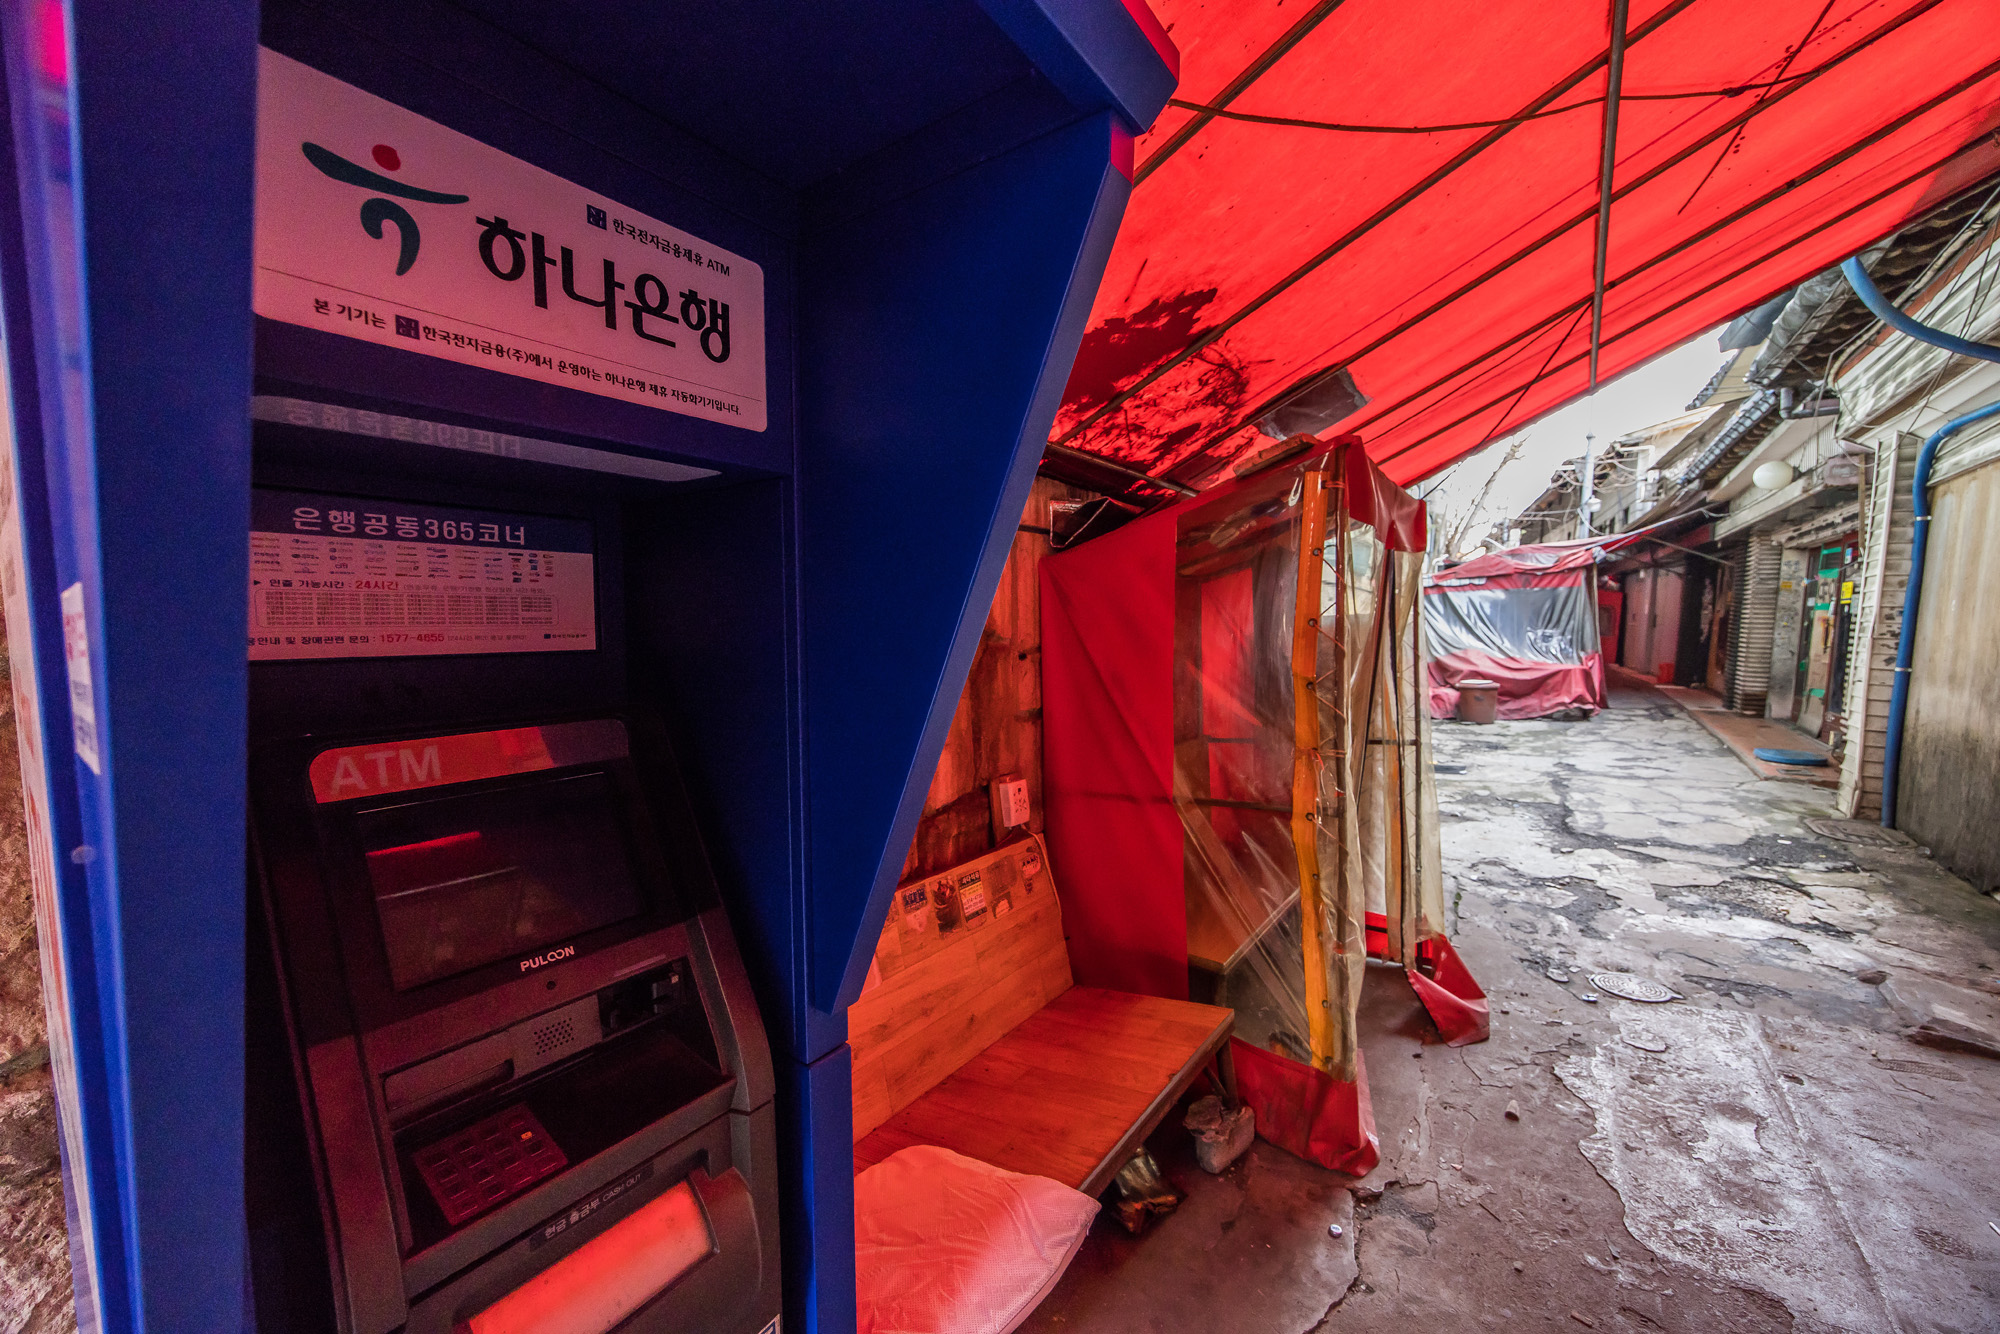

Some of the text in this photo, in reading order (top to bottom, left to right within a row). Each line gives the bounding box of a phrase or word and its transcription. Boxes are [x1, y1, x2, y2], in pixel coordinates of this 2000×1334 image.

[612, 218, 730, 276] 한국전자금융제휴 ATM
[476, 215, 731, 364] 하나은행
[313, 297, 742, 416] 본 기기는 한국전자금융(주)에서 운영하는 하나은행 제휴 자동화기기입니다.
[292, 507, 525, 545] 은행공동365코너
[298, 580, 345, 589] 가능시간
[354, 580, 399, 591] 24시간
[349, 634, 370, 644] 문의
[330, 745, 442, 795] ATM
[544, 1218, 567, 1239] 현금
[602, 1183, 625, 1202] CASH
[626, 1173, 641, 1187] OUT
